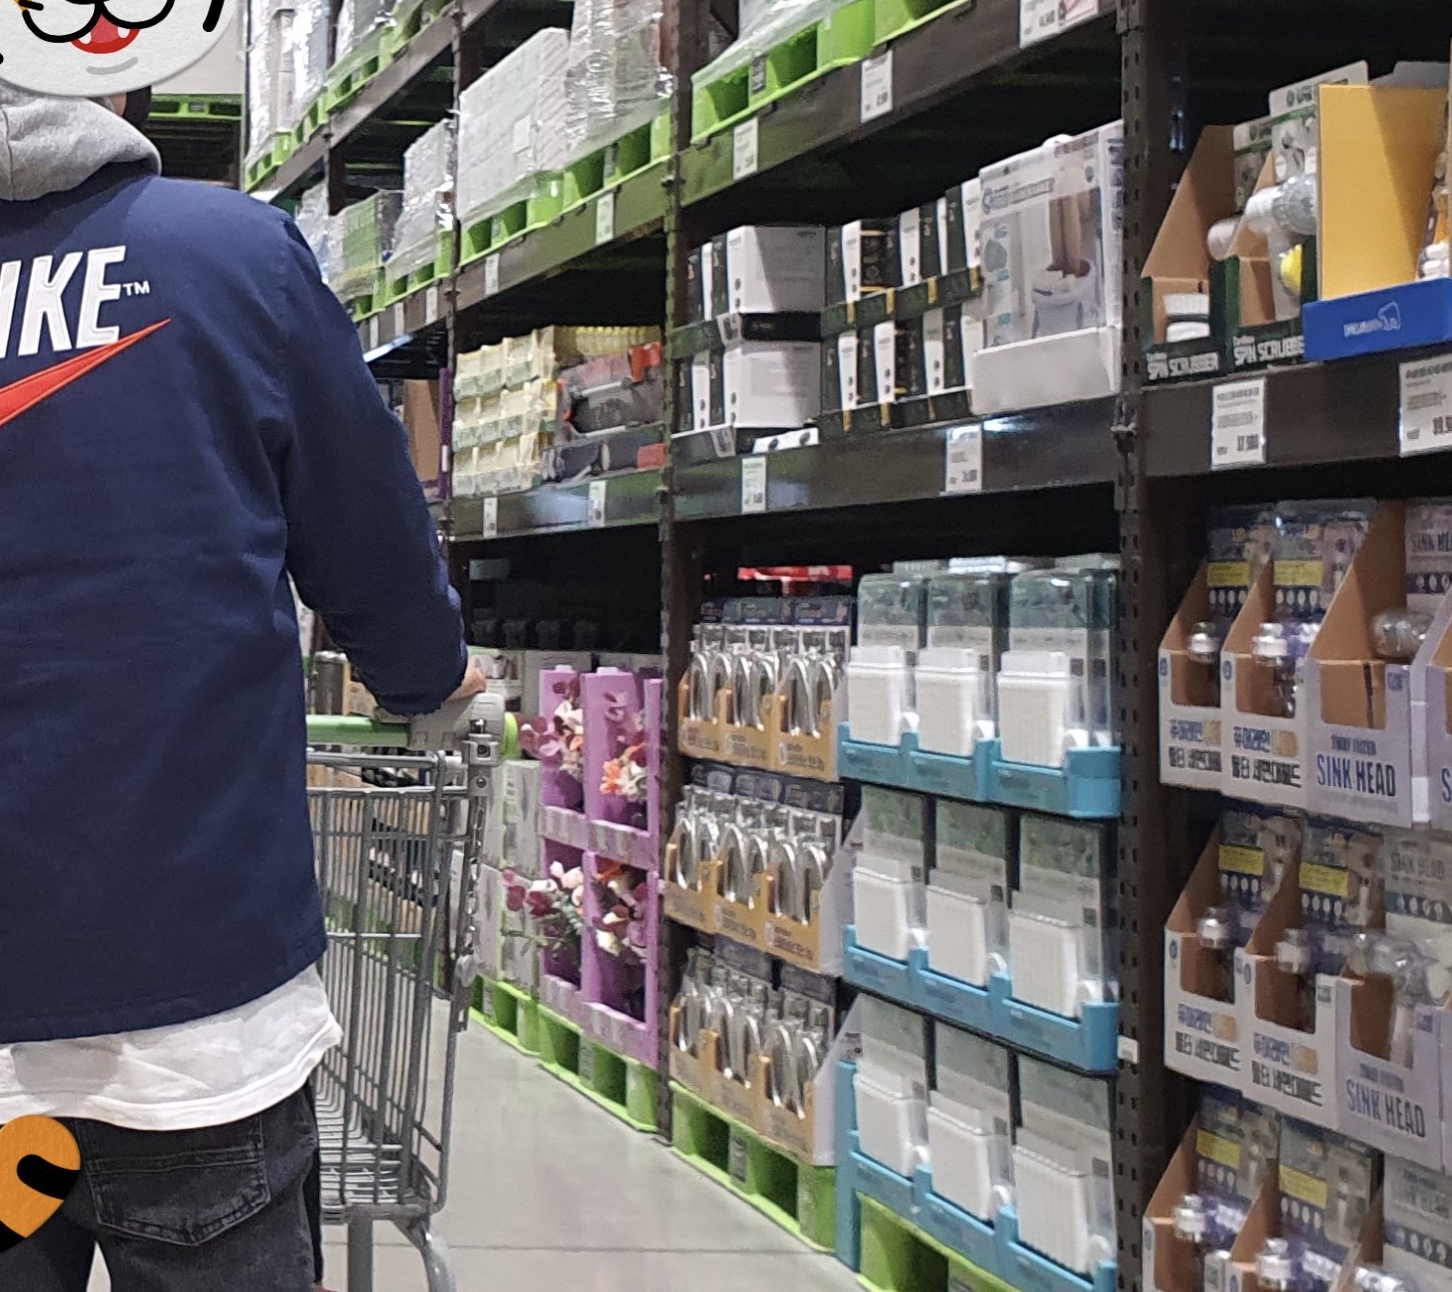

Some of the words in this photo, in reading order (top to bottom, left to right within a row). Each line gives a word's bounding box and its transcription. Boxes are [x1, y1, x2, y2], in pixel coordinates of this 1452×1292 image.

[1233, 345, 1256, 366] SPIN
[1317, 752, 1353, 791] SINK
[1356, 759, 1397, 798] HEAD
[1346, 1077, 1382, 1122] SINK
[1385, 1088, 1427, 1139] HEAD
